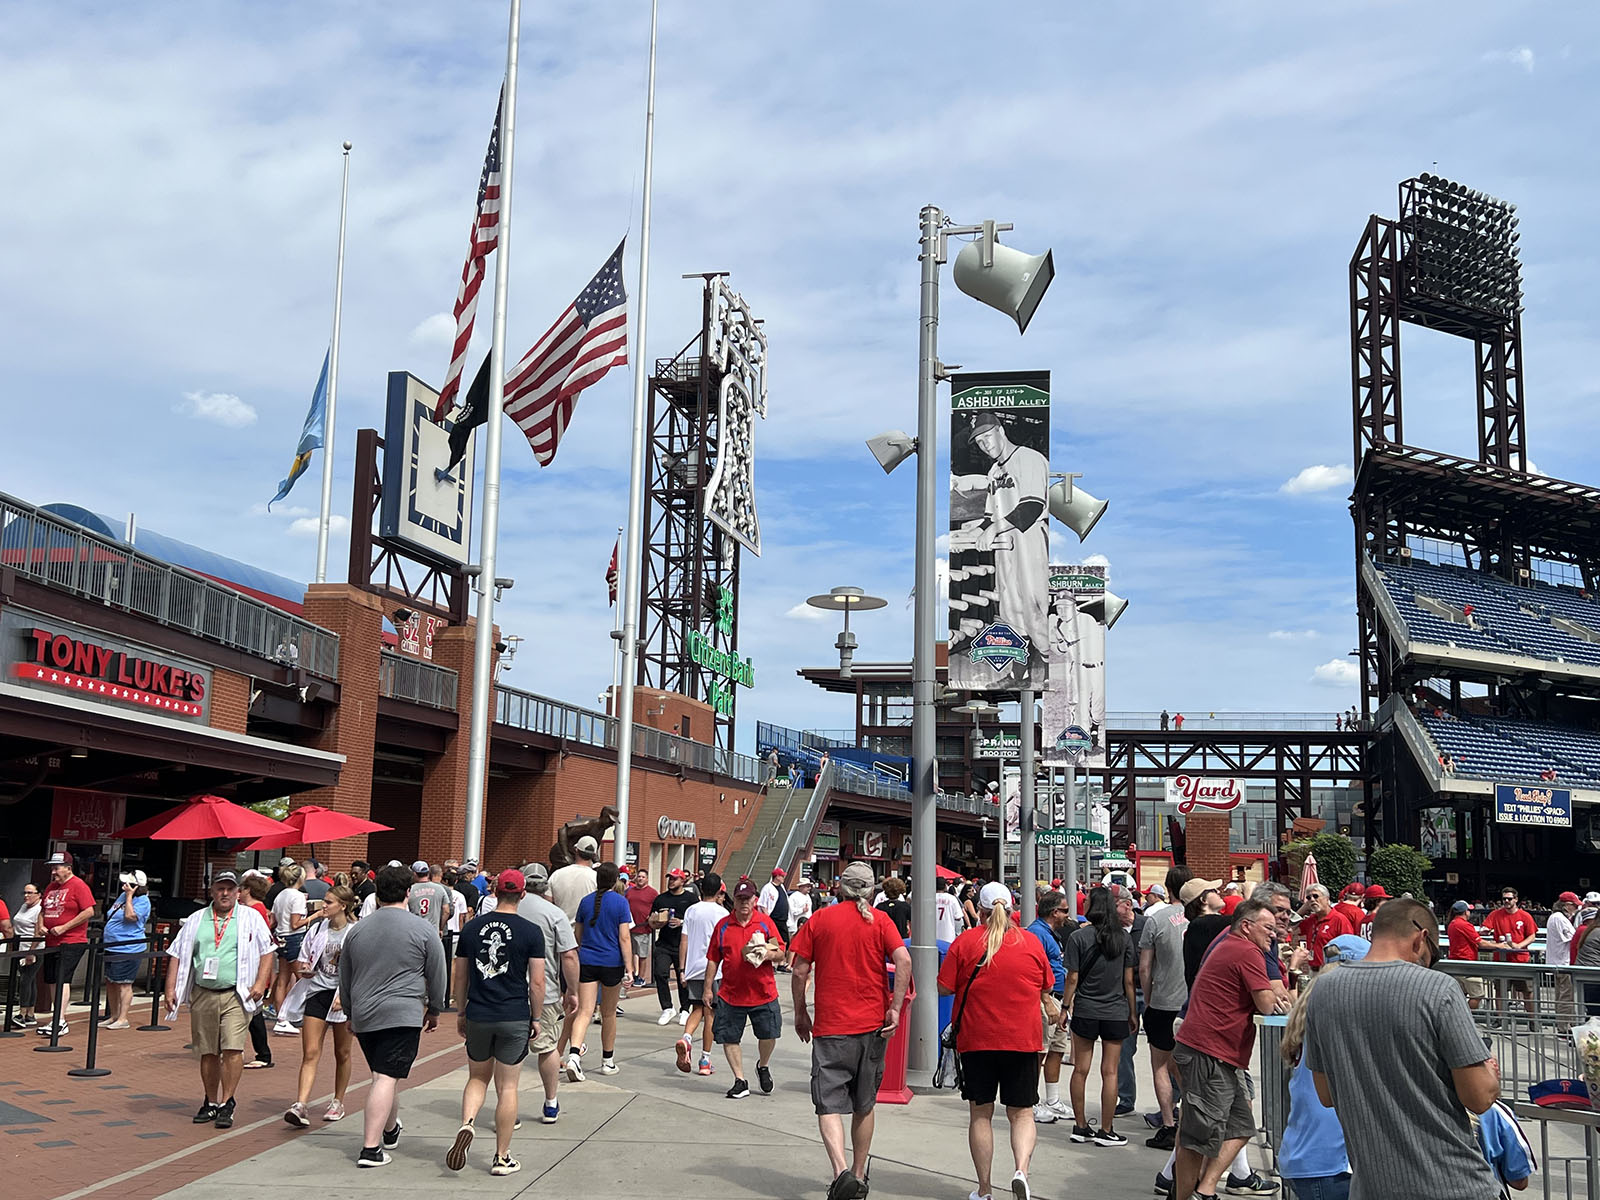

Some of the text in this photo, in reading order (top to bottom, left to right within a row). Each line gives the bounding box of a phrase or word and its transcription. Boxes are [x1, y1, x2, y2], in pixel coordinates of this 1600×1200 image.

[957, 395, 1015, 408] ASHBURN
[985, 635, 1012, 645] Phillies
[32, 628, 205, 701] TONY LUKE'S
[690, 630, 755, 688] Citizens Bank
[711, 680, 735, 718] Park
[1175, 775, 1241, 814] Yard
[1514, 788, 1553, 807] Need Help?
[1504, 803, 1517, 812] TEXT
[1499, 812, 1514, 821] ISSUE
[1520, 814, 1546, 824] LOCATION
[1546, 816, 1554, 824] TO
[669, 819, 697, 839] TOYOTA
[1038, 834, 1082, 845] ASHBURN
[740, 883, 747, 891] P
[420, 897, 430, 916] 3
[938, 907, 945, 921] 7
[1515, 920, 1524, 930] P
[1560, 1080, 1572, 1093] P
